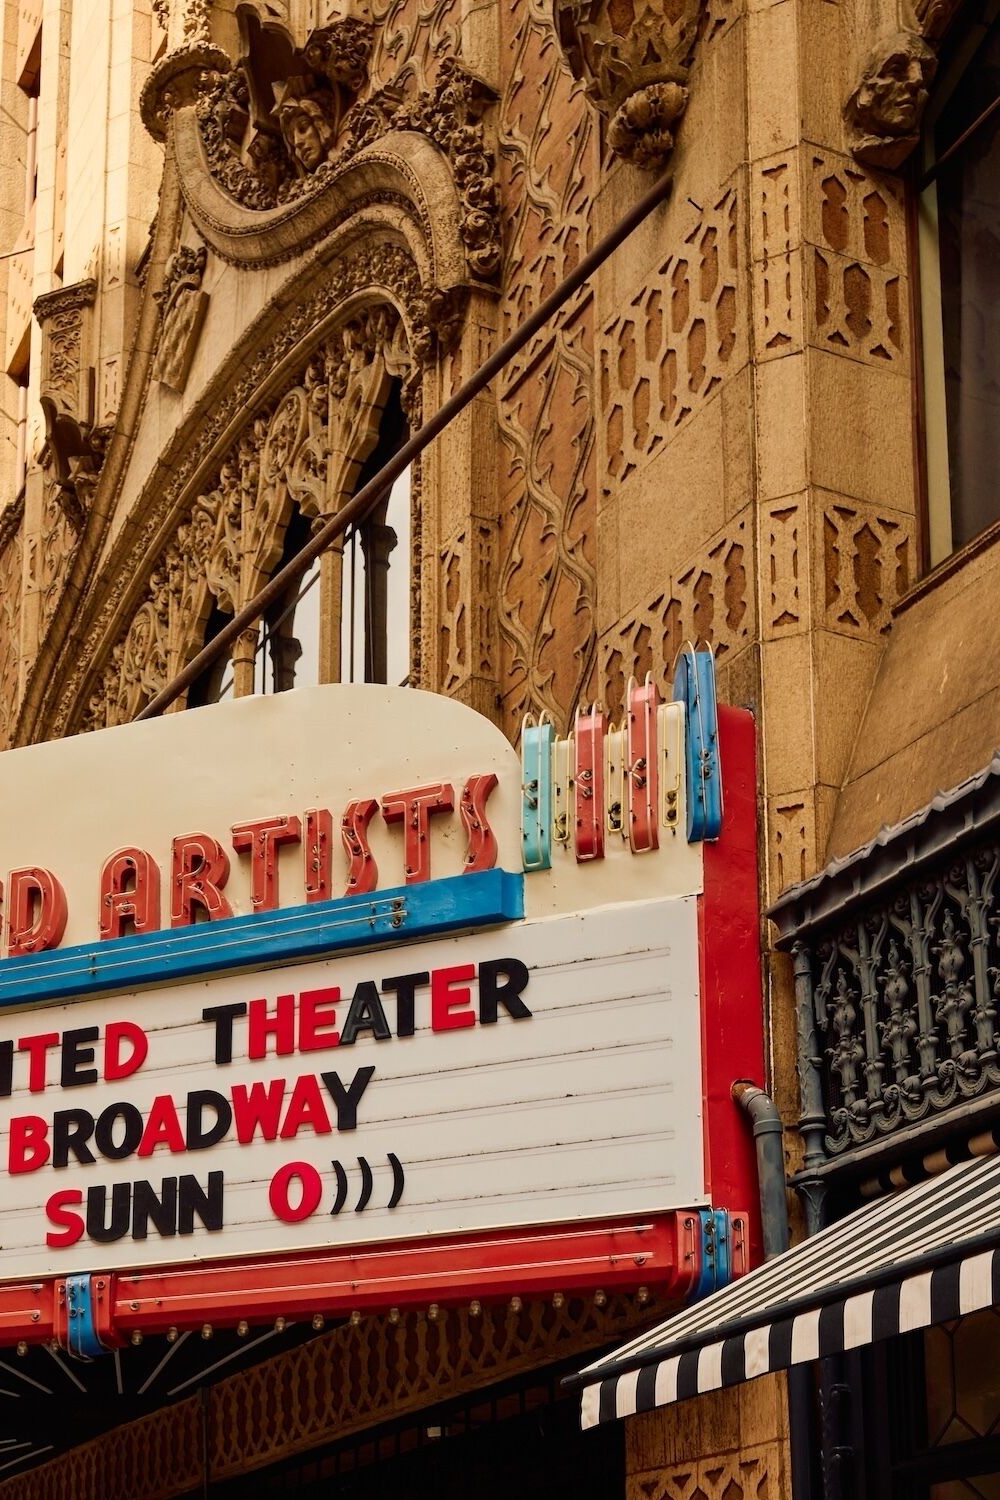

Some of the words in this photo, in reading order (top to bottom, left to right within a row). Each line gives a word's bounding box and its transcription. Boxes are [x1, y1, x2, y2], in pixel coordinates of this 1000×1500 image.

[99, 774, 498, 941] ARTISTS
[203, 957, 534, 1065] THEATER
[8, 1065, 376, 1175] BROADWAY
[45, 1170, 224, 1249] SUNN
[269, 1152, 406, 1223] O)))
